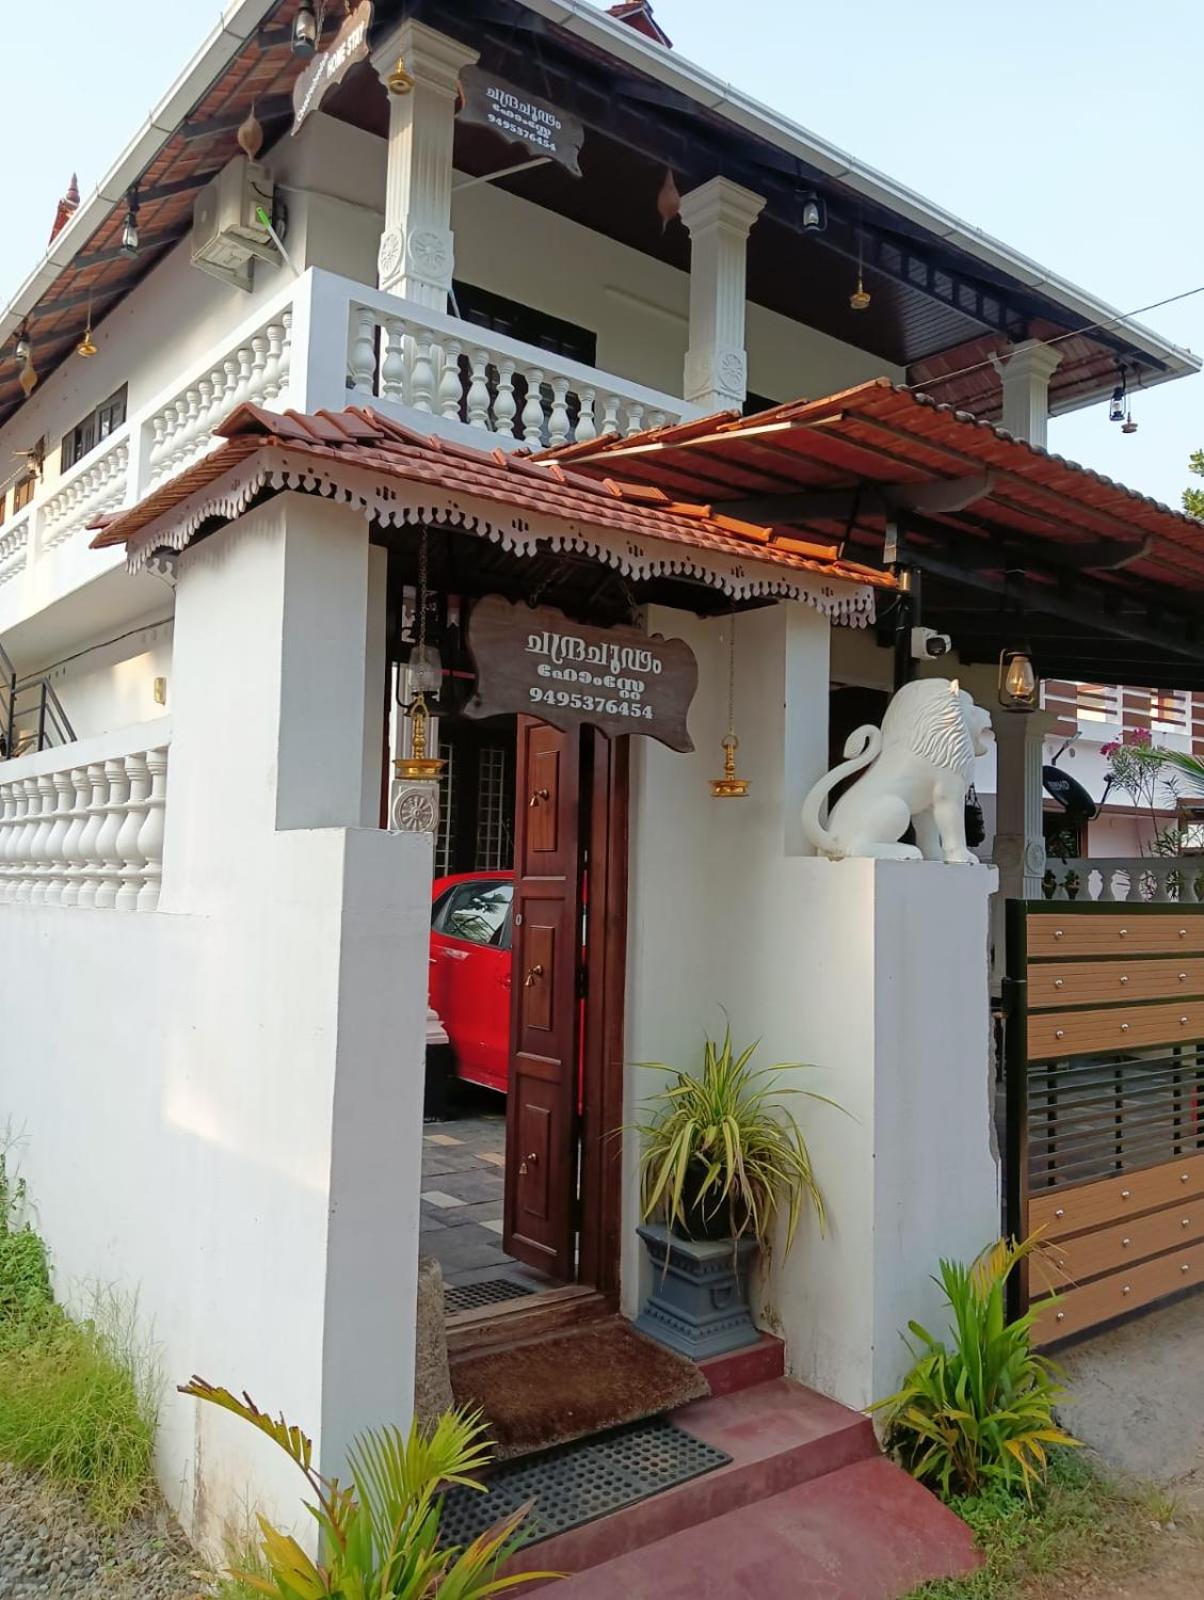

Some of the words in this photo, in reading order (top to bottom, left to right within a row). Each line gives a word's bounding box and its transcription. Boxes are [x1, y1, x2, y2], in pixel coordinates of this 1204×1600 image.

[487, 113, 556, 151] 9495376454
[537, 663, 645, 700] ഹോംസ്റ്റേ
[529, 686, 653, 719] 9495376454
